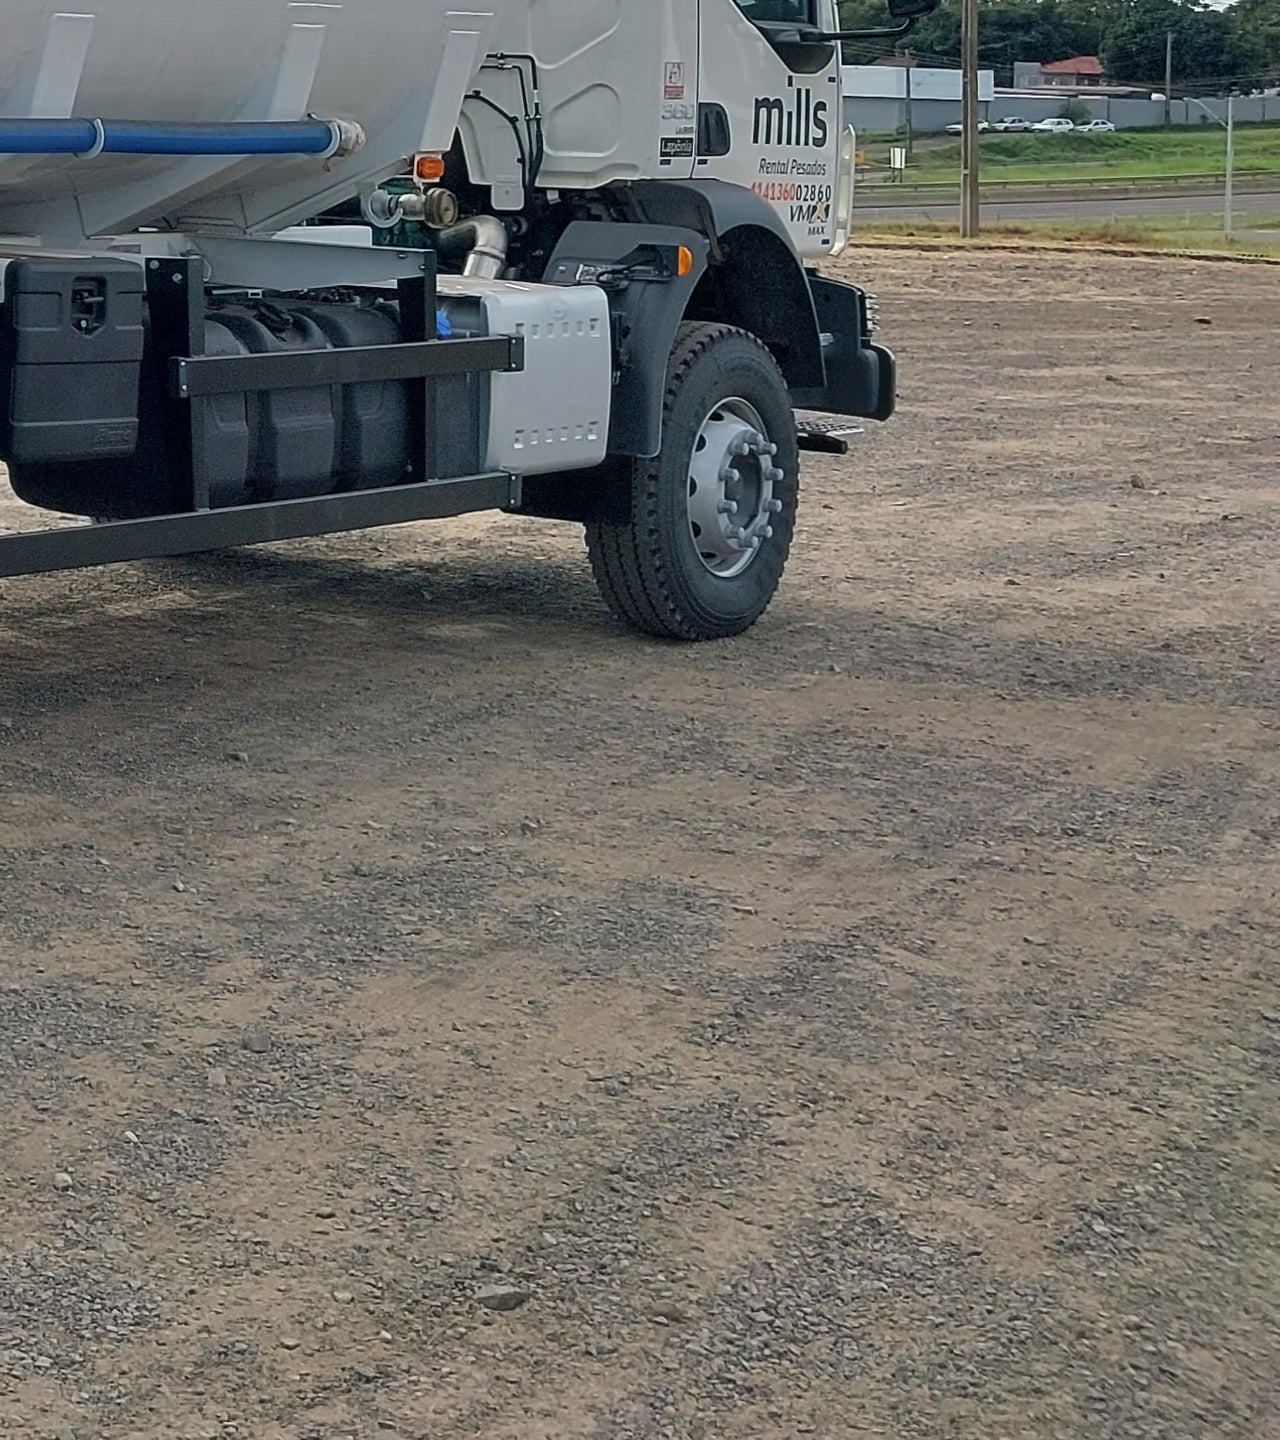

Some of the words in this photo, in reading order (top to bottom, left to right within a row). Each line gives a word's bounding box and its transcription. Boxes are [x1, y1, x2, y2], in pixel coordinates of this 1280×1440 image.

[752, 75, 828, 148] mills
[758, 157, 789, 175] Rental
[790, 158, 827, 176] Pesados
